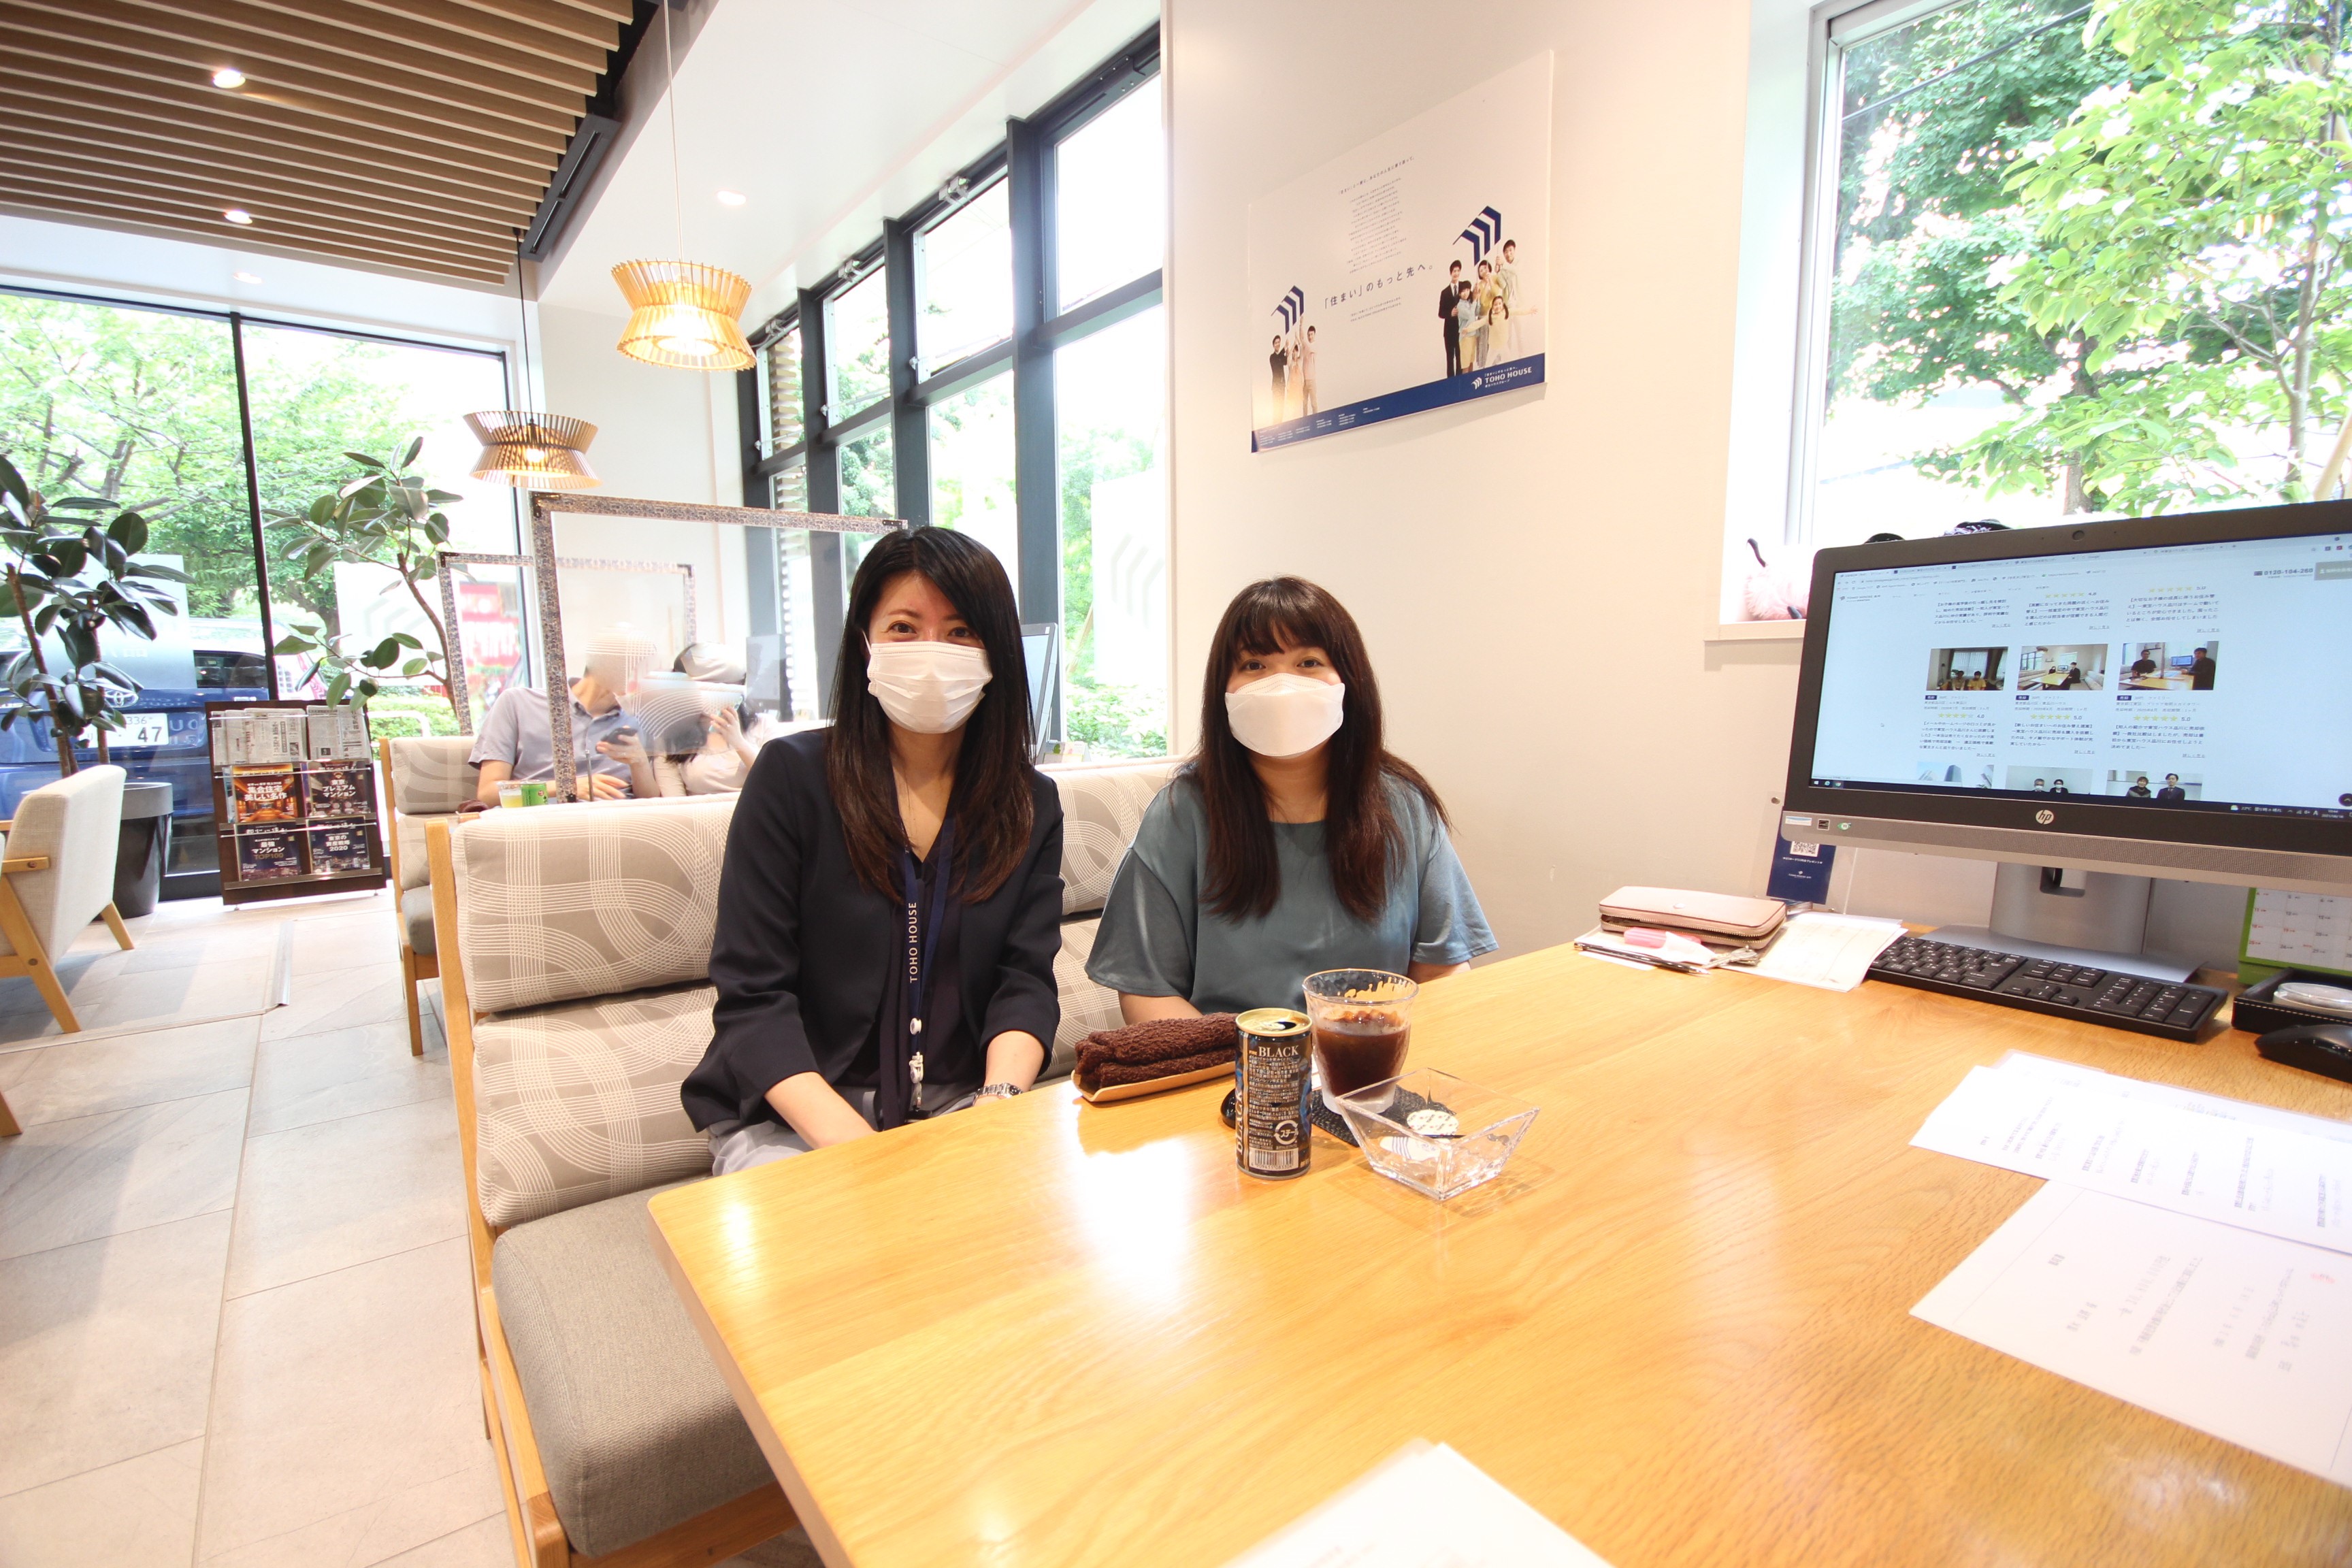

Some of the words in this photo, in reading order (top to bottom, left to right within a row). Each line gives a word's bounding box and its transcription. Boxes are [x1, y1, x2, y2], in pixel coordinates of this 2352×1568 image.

[1324, 264, 1433, 309] 「住まい」のもっと先へ。
[1484, 374, 1505, 383] TOHO
[1507, 367, 1532, 378] HOUSE
[137, 726, 162, 743] 47
[244, 792, 287, 802] 美しい名作
[247, 785, 283, 794] 集合住宅
[2038, 809, 2053, 824] hp
[908, 902, 917, 943] HOUSE
[909, 947, 918, 983] TOHO
[1258, 1045, 1299, 1058] BLACK
[1280, 1128, 1299, 1138] スチール
